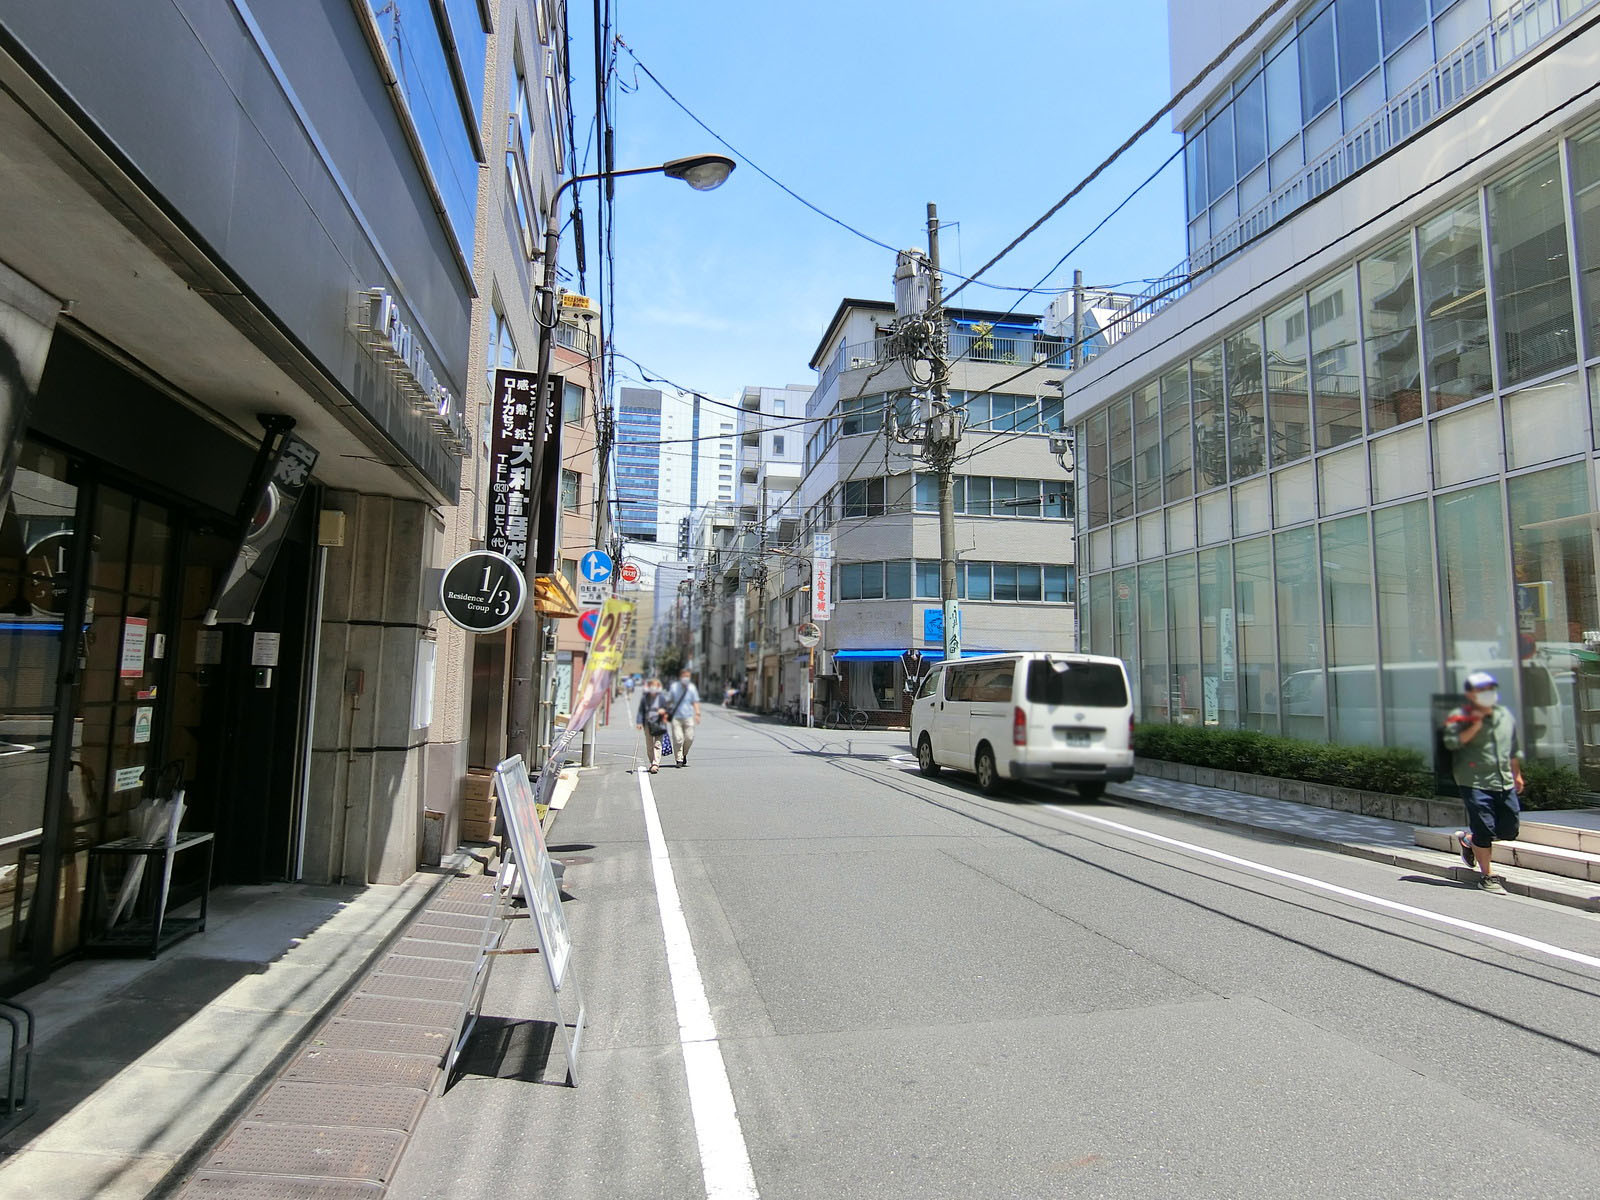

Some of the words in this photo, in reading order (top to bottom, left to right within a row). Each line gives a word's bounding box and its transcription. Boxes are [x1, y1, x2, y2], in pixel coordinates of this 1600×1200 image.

[502, 377, 516, 439] ロールカセット
[514, 379, 530, 440] 感熱紙
[447, 591, 485, 603] Residence
[467, 602, 490, 614] Group
[480, 566, 511, 616] 1/3
